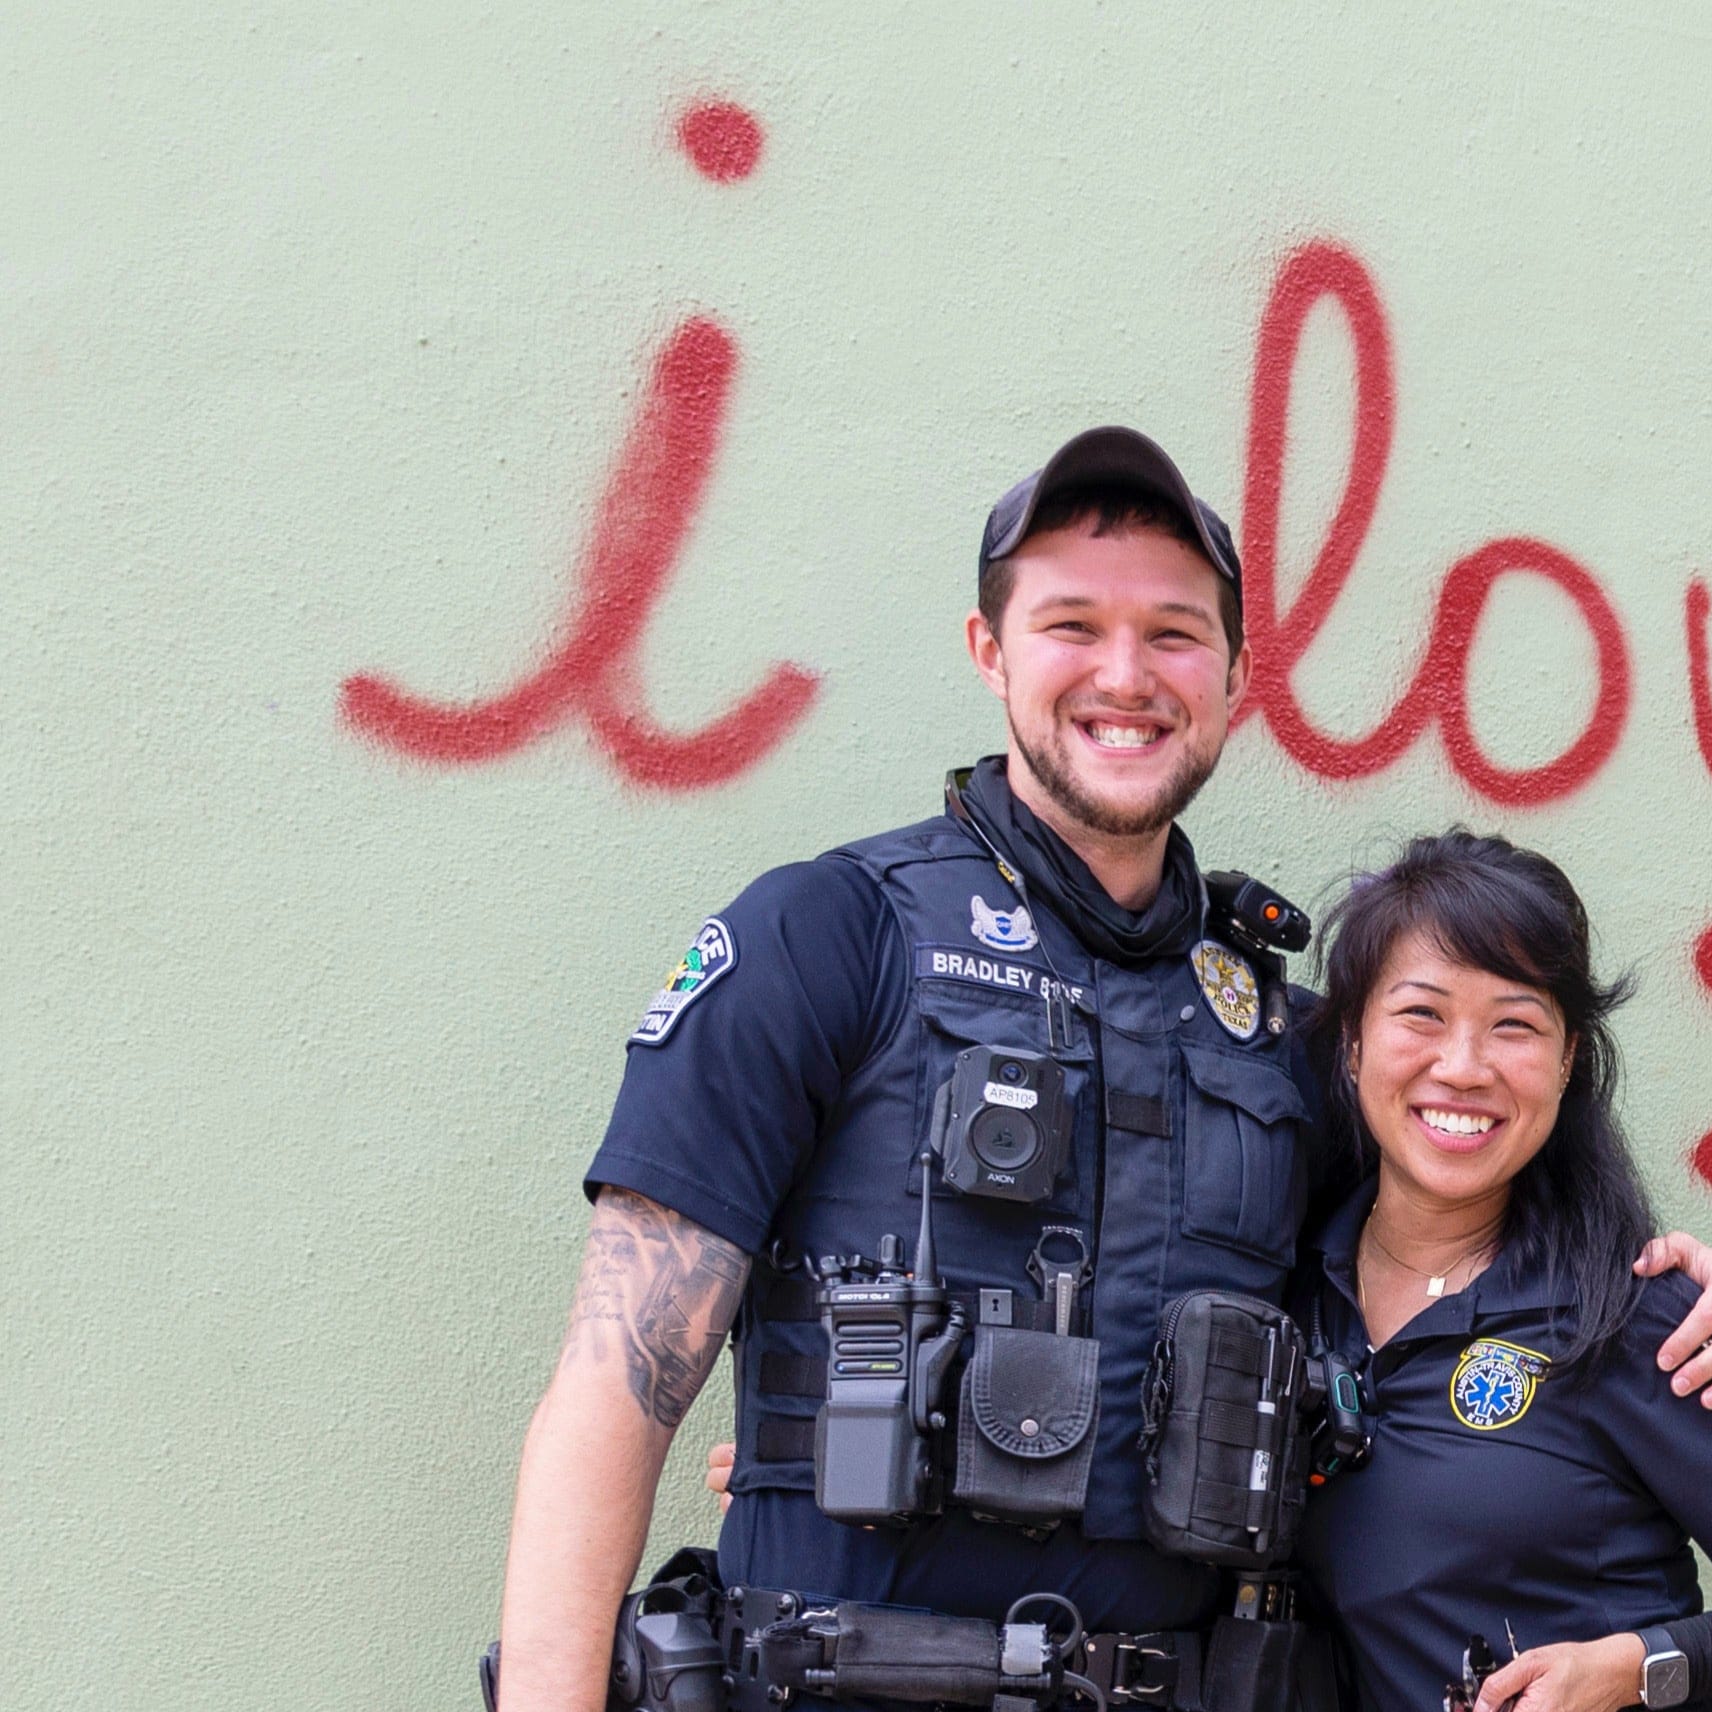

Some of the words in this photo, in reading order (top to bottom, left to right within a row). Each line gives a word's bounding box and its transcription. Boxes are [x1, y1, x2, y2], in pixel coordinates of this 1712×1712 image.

[346, 103, 816, 790] i
[932, 951, 1034, 990] BRADLEY
[989, 1087, 1036, 1107] AP8105
[987, 1172, 1016, 1185] AXON
